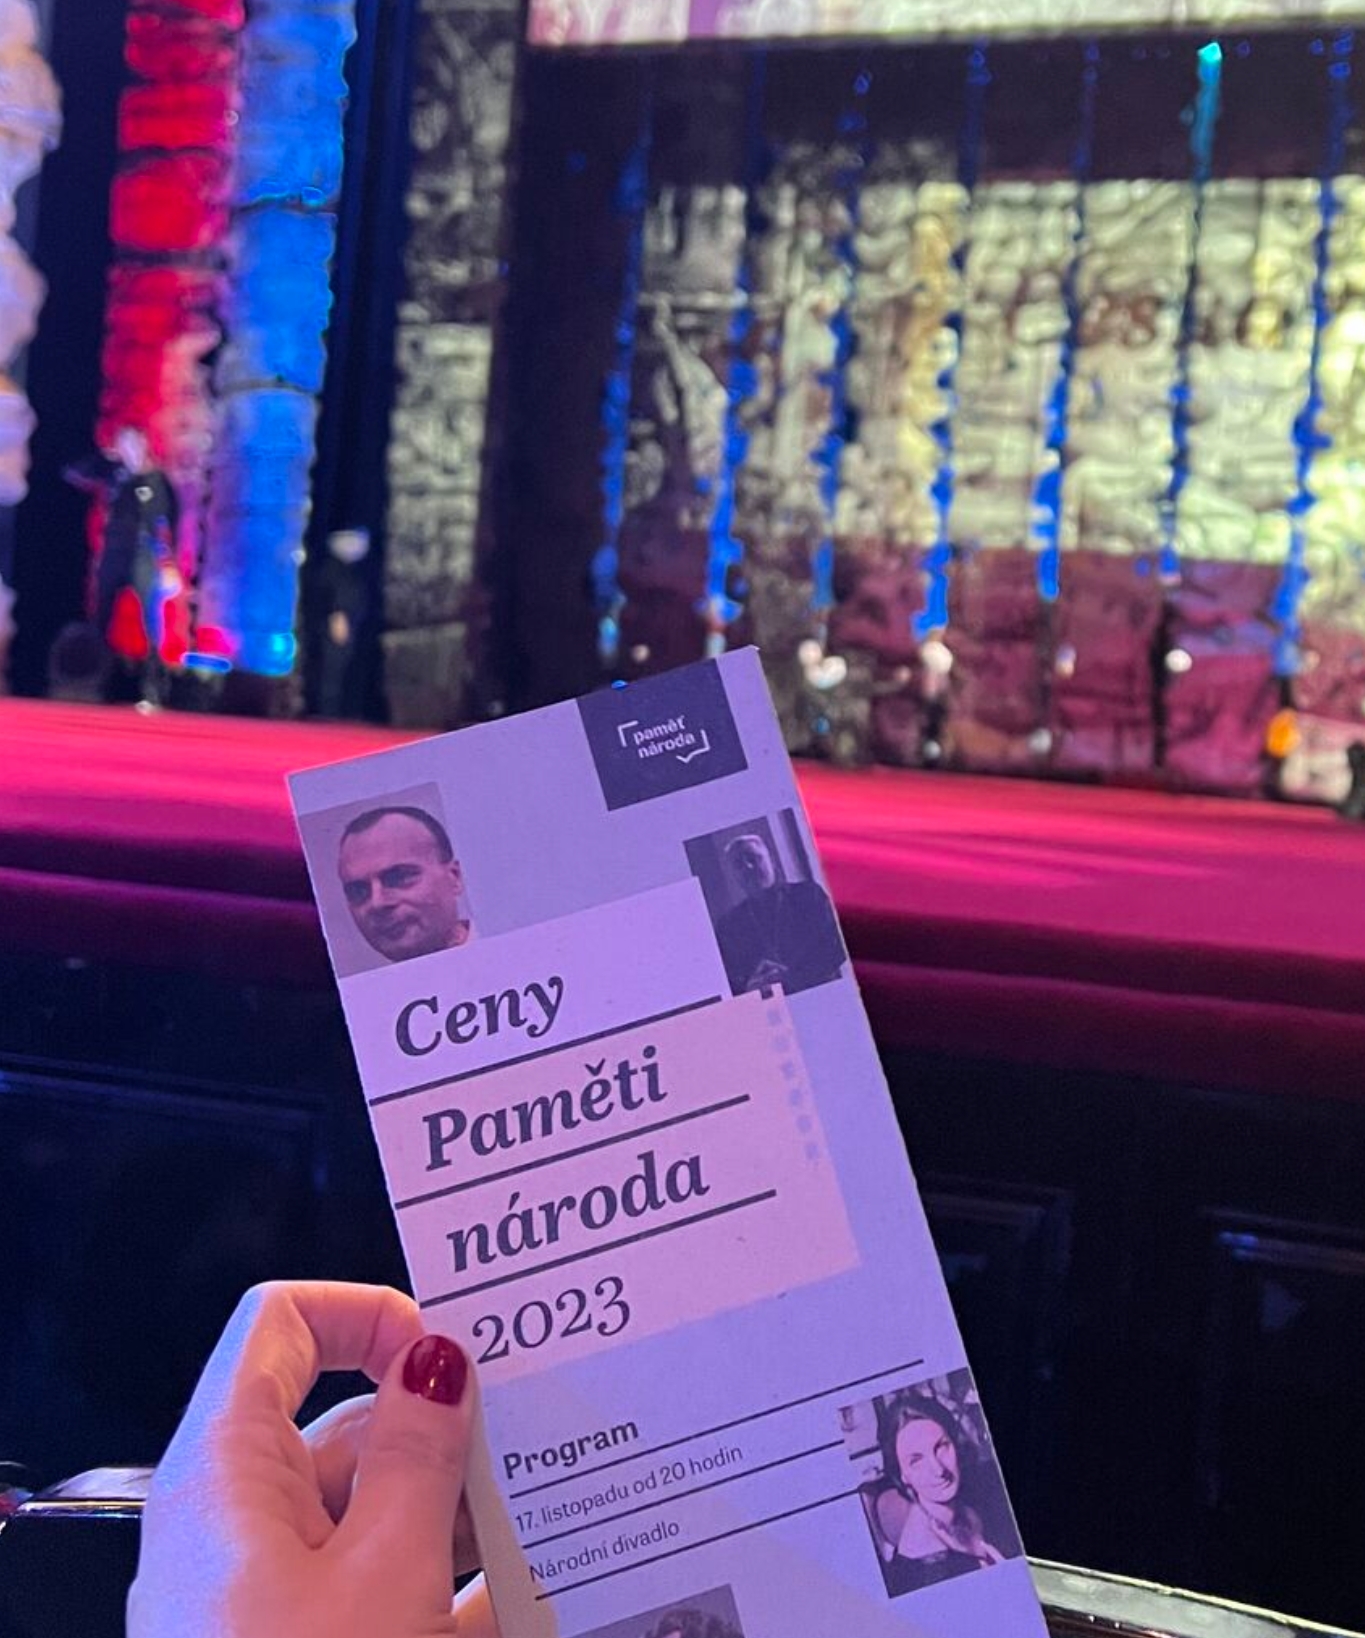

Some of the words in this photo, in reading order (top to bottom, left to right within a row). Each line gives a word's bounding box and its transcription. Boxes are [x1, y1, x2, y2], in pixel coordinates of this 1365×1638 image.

[638, 733, 696, 758] národa
[394, 974, 566, 1058] Ceny
[422, 1044, 669, 1173] Paměti
[446, 1148, 711, 1275] národa
[471, 1275, 632, 1365] 2023
[502, 1420, 639, 1480] Program
[515, 1511, 539, 1533] 17.
[540, 1483, 630, 1528] listopadu
[632, 1470, 657, 1495] od
[659, 1461, 686, 1486] 20
[690, 1444, 744, 1476] hodin
[528, 1547, 609, 1584] Národní
[612, 1519, 681, 1557] divadlo
